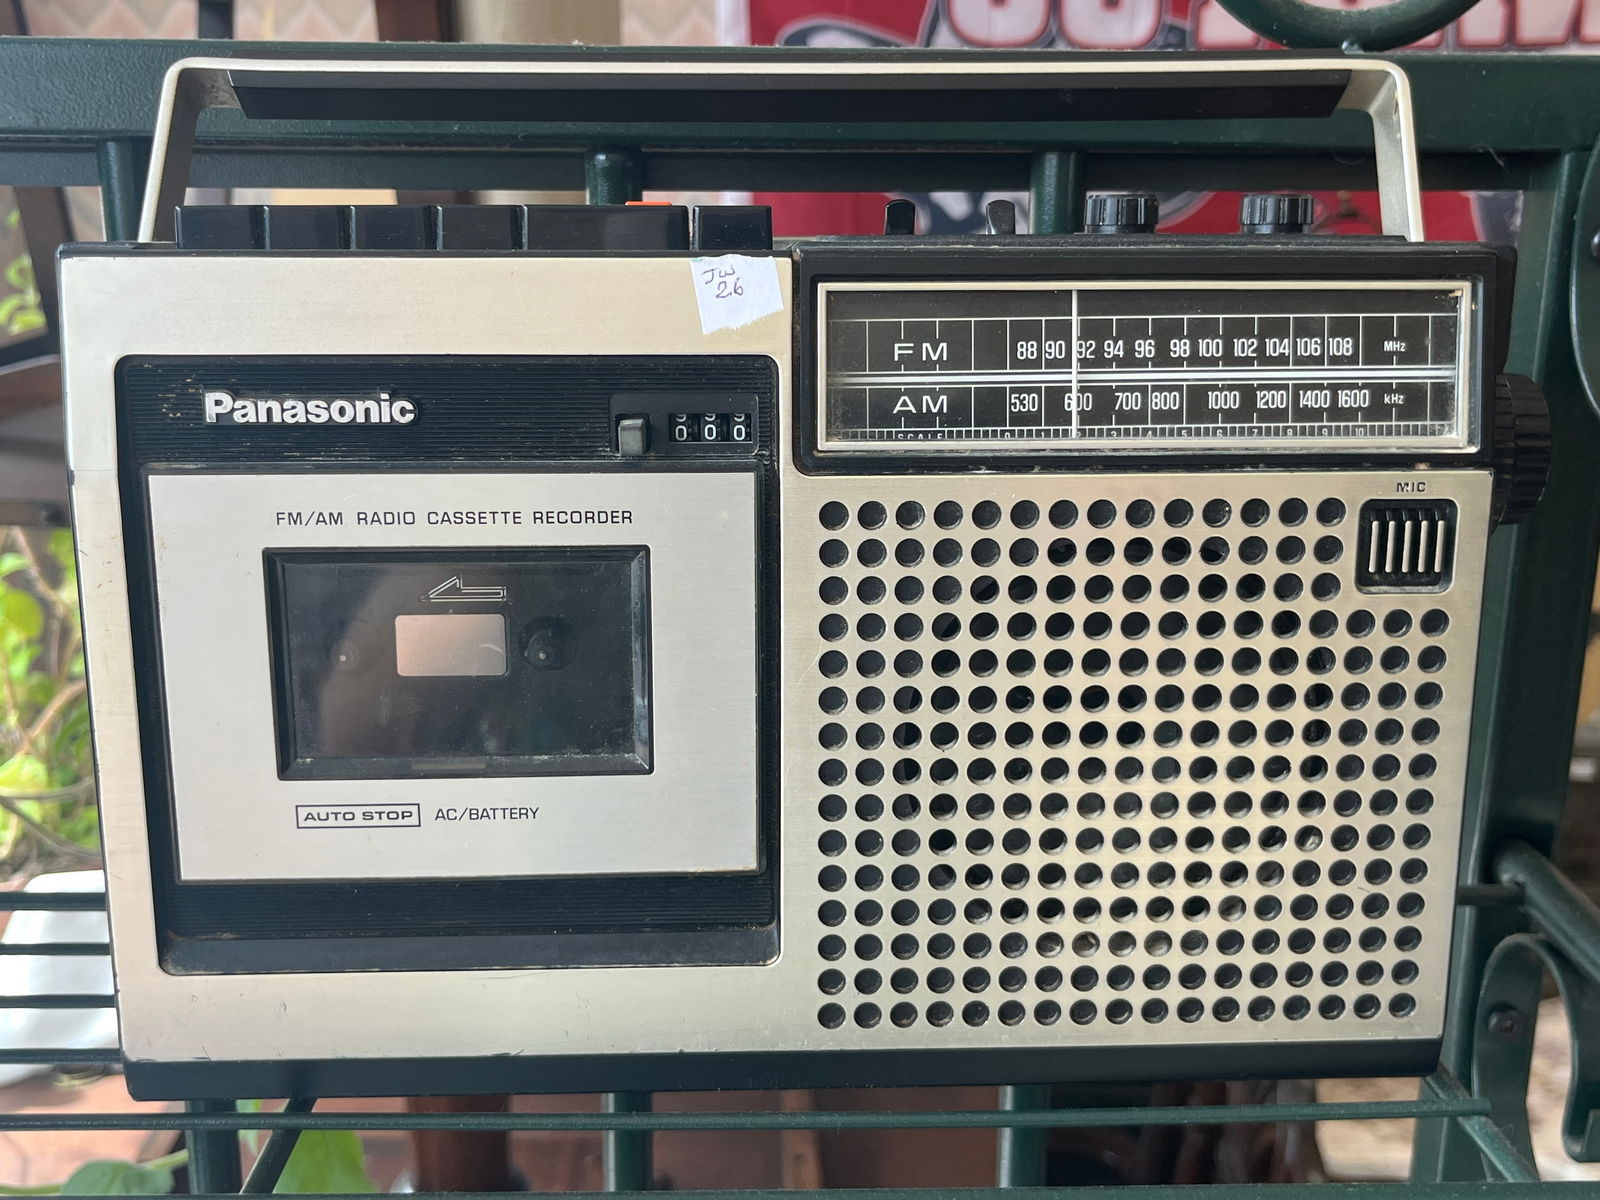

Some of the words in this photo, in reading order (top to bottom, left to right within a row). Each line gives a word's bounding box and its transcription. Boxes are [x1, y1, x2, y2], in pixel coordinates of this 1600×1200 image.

[893, 342, 948, 362] FM
[1016, 340, 1038, 360] 88
[1045, 340, 1066, 360] 90
[1076, 340, 1096, 359] 92
[1103, 339, 1124, 359] 94
[1134, 339, 1155, 358] 96
[1169, 338, 1190, 358] 98
[1198, 338, 1222, 358] 100
[1233, 338, 1257, 357] 102
[1265, 337, 1290, 357] 104
[1296, 337, 1321, 357] 106
[1328, 337, 1352, 356] 108
[1383, 340, 1406, 352] MHz
[205, 391, 415, 424] Panasonic
[892, 395, 948, 414] AM
[1010, 393, 1038, 412] 530
[1114, 392, 1141, 411] 700
[1151, 391, 1179, 410] 800
[1207, 391, 1239, 409] 1000
[1256, 390, 1287, 408] 1200
[1299, 389, 1330, 408] 1400
[1337, 389, 1369, 408] 1600
[1384, 393, 1404, 405] kHz
[1396, 482, 1426, 492] MIC
[276, 511, 343, 526] FM/AM
[357, 511, 416, 525] RADIO
[427, 511, 522, 525] CASSETTE
[533, 510, 633, 524] RECORDER
[303, 812, 356, 822] AUTO
[362, 811, 413, 821] STOP
[434, 807, 540, 821] AC/BATTERY
